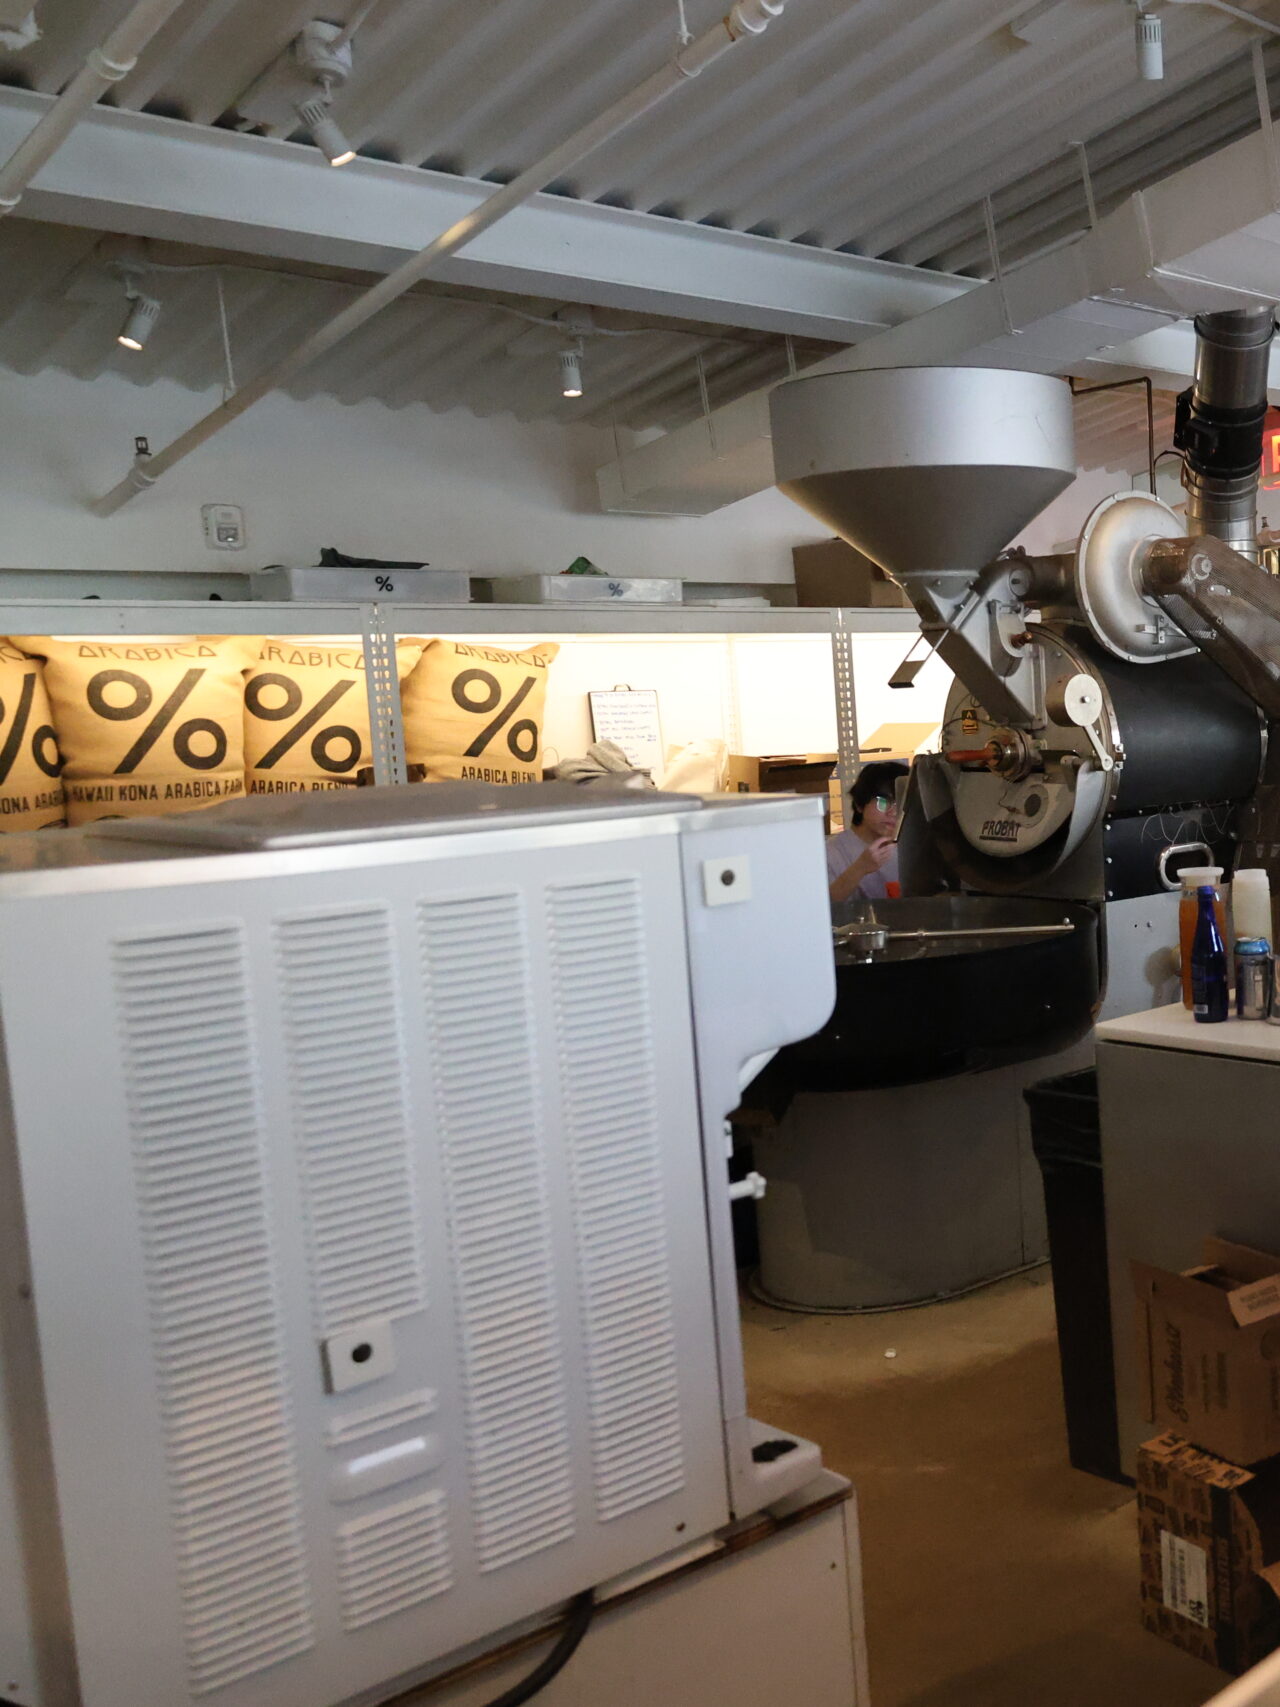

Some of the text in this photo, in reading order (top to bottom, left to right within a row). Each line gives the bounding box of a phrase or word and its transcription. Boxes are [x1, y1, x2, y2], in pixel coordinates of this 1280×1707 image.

[78, 645, 217, 661] ARABICA
[461, 765, 508, 784] ARABICA
[119, 783, 158, 801] KONA
[164, 781, 221, 800] ARABICA
[250, 779, 305, 795] ARABICA
[0, 797, 31, 814] ONA
[981, 820, 1021, 837] PROBAT
